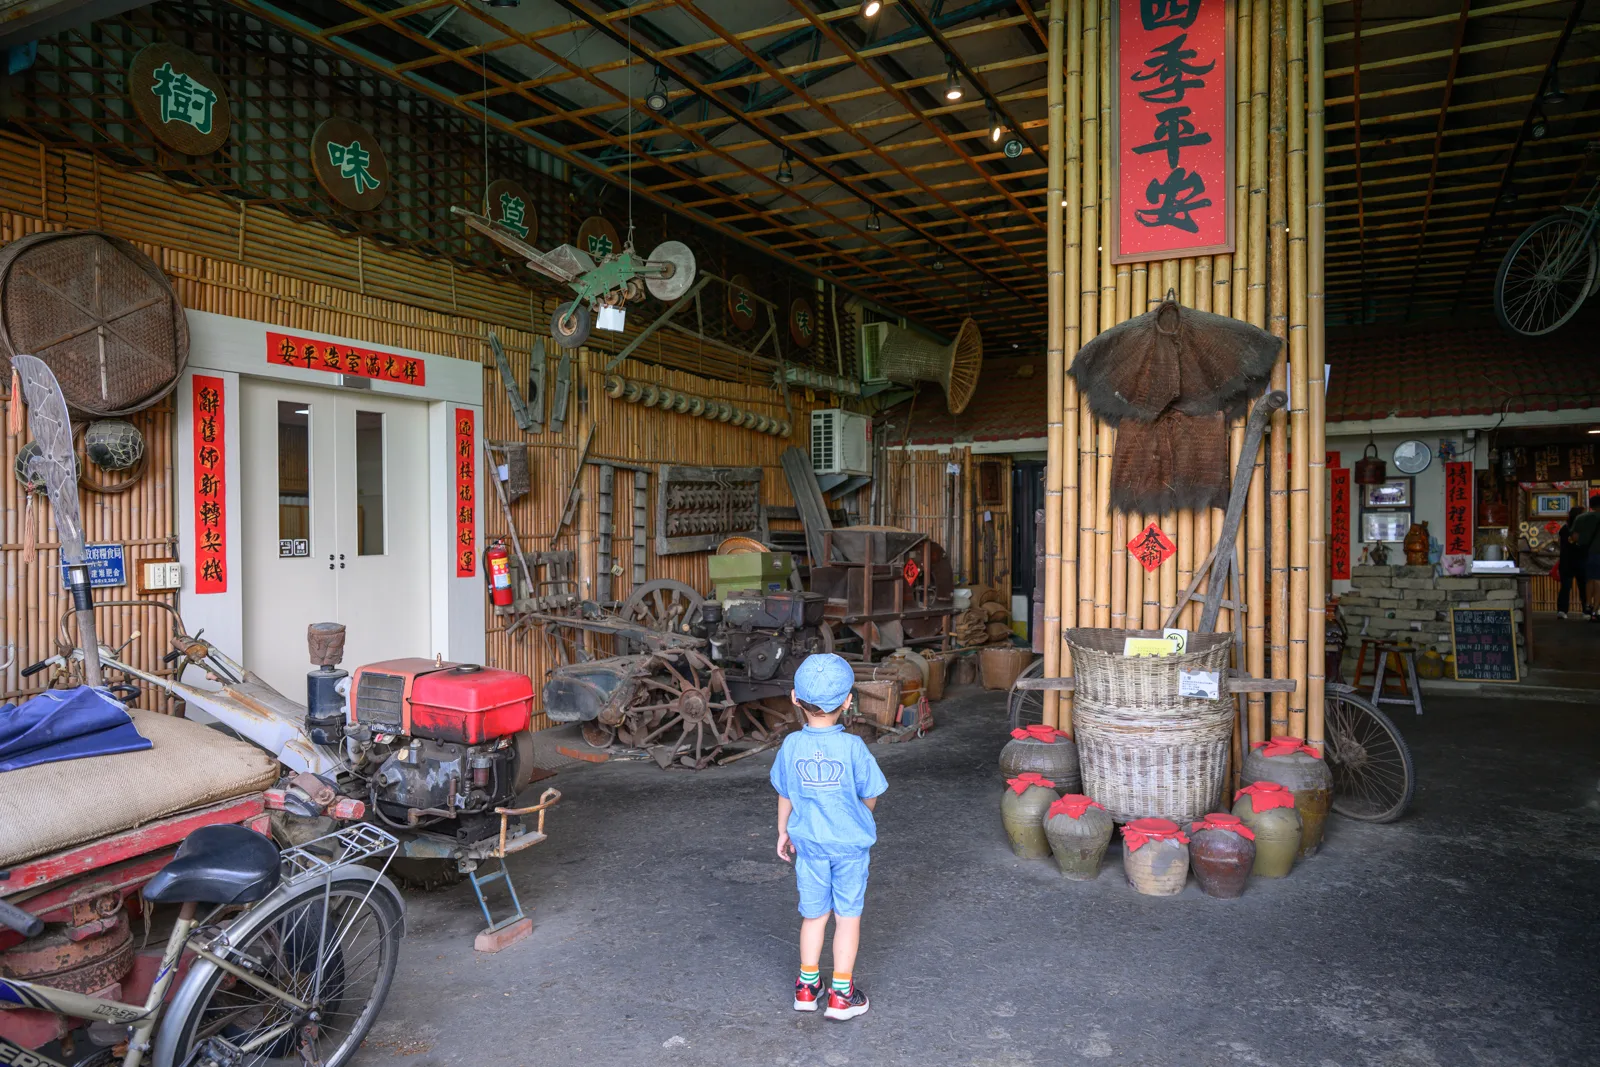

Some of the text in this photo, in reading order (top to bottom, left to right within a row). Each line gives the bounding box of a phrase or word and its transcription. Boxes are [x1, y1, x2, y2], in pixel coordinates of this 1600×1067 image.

[151, 61, 218, 135] 樹
[1130, 0, 1216, 234] 四季平安
[327, 140, 380, 194] 味
[796, 310, 812, 337] 味
[458, 419, 474, 572] 迎新接福翻好運
